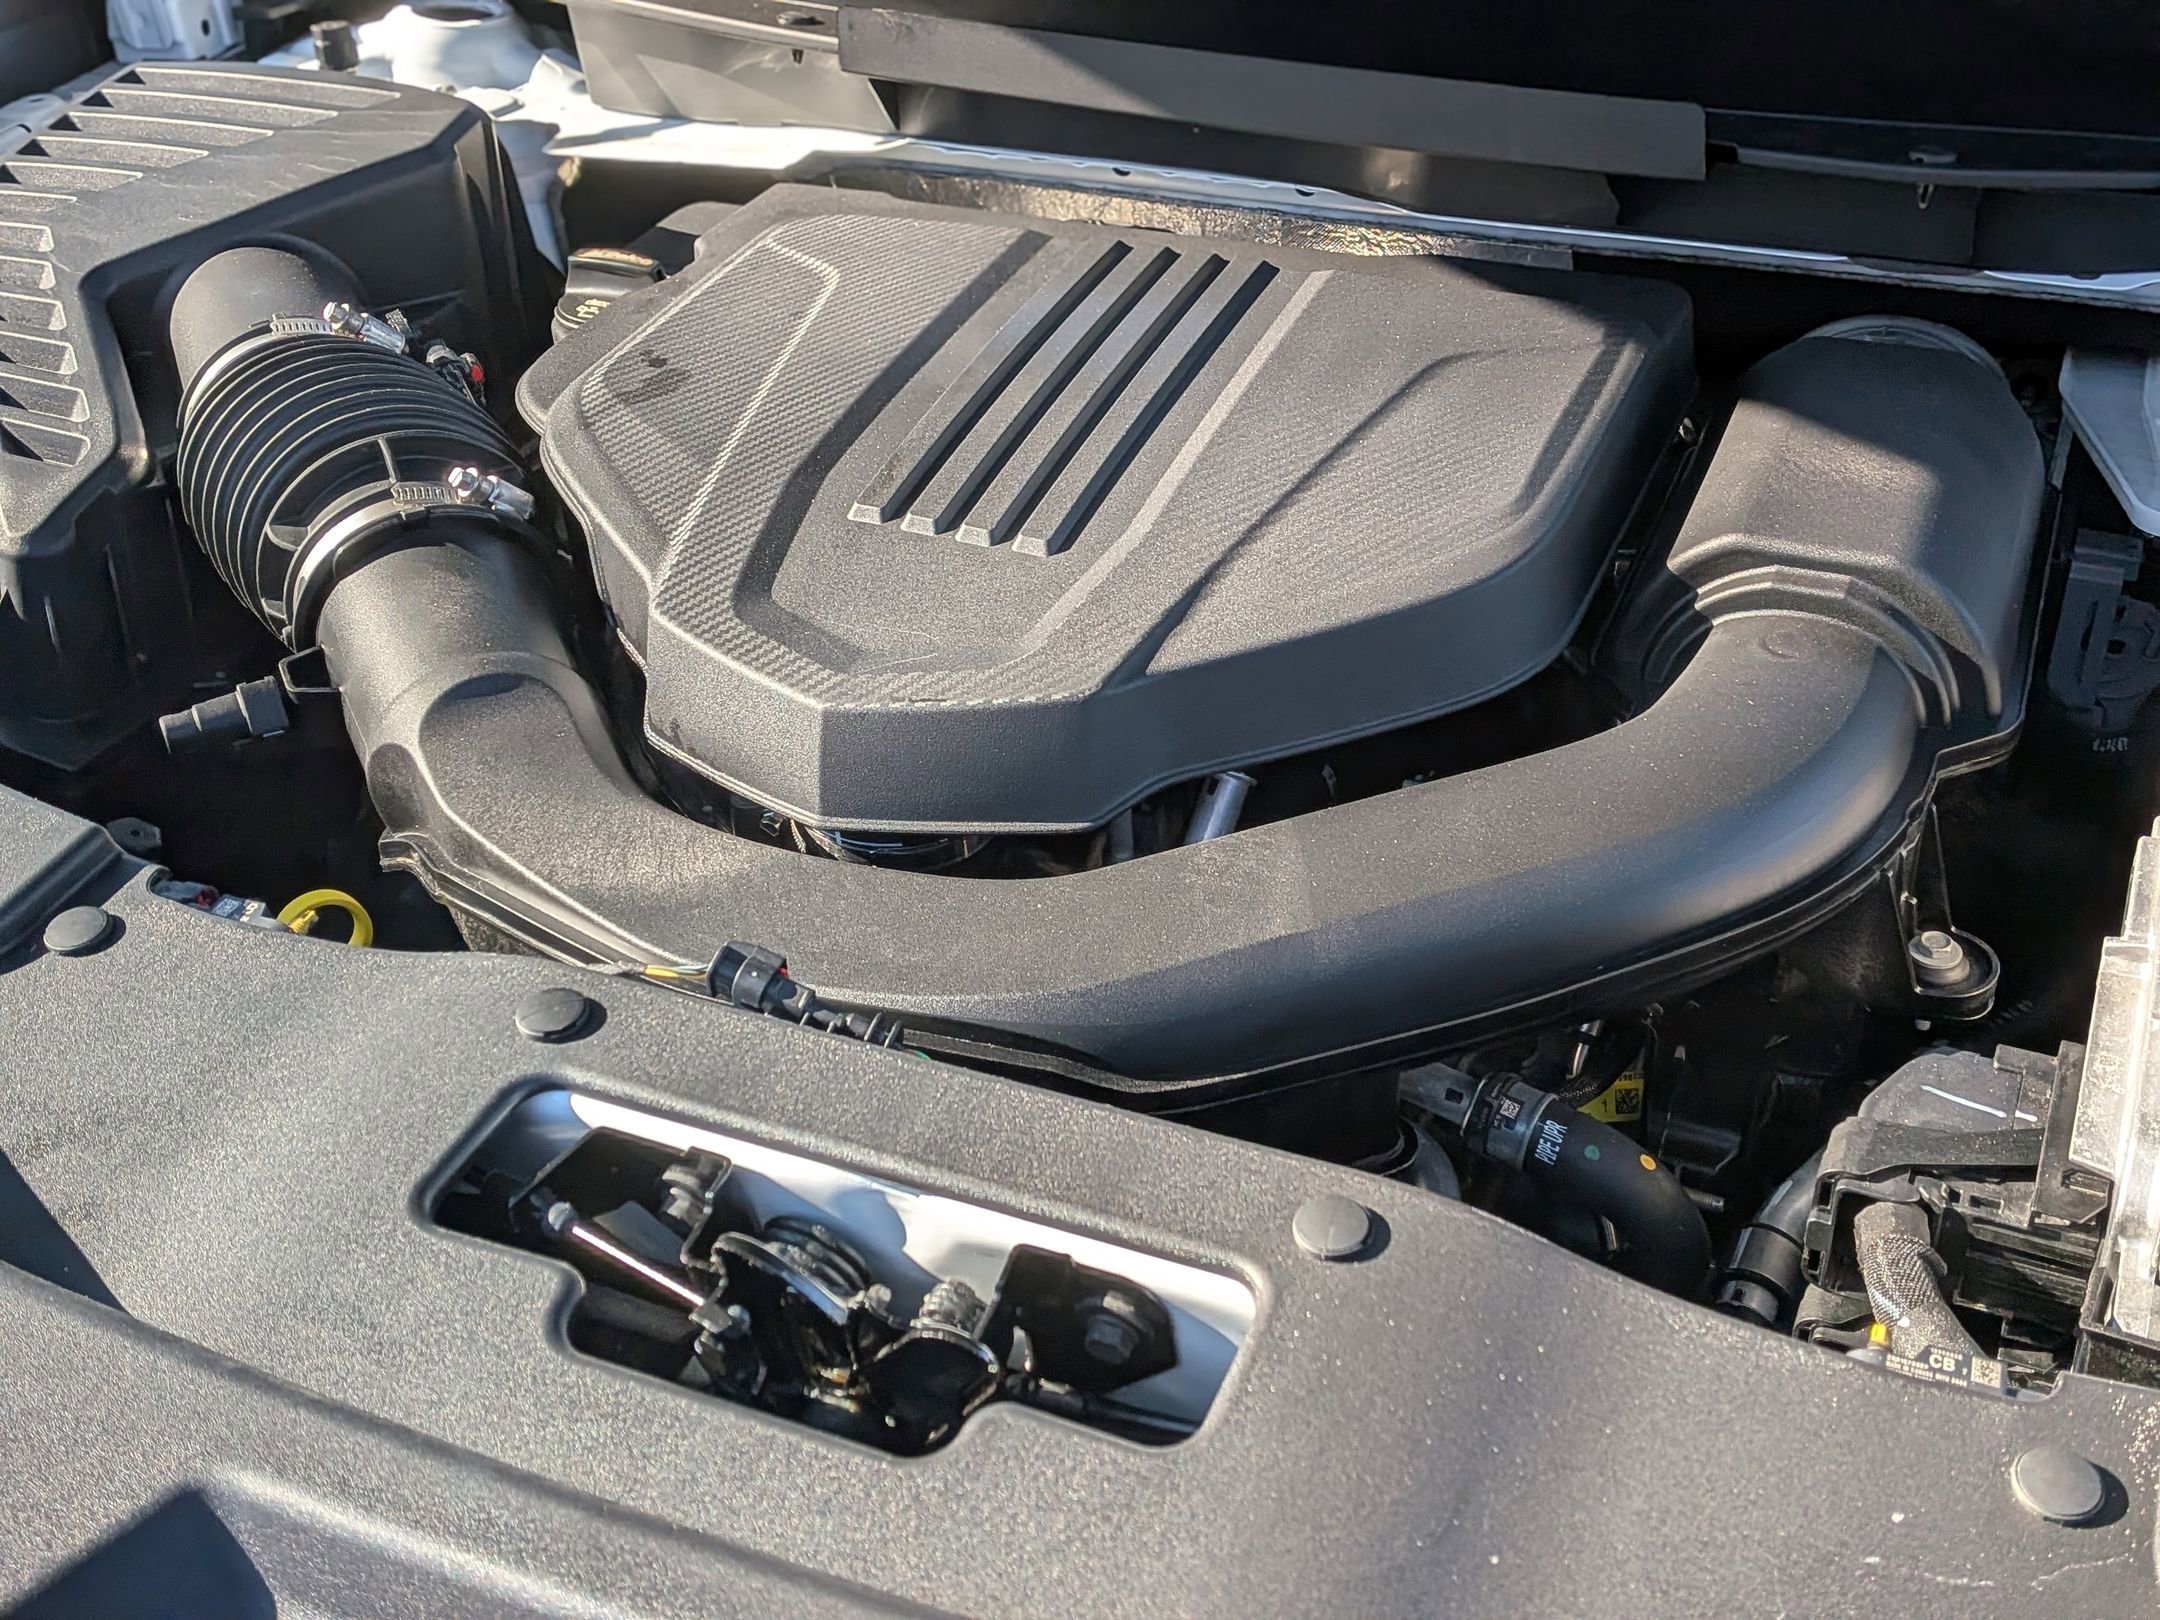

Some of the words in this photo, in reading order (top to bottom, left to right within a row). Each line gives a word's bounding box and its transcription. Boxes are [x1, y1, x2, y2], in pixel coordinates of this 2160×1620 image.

[1541, 1119, 1569, 1144] UPR
[1534, 1138, 1560, 1166] PIPE
[1928, 1353, 1957, 1372] CB
